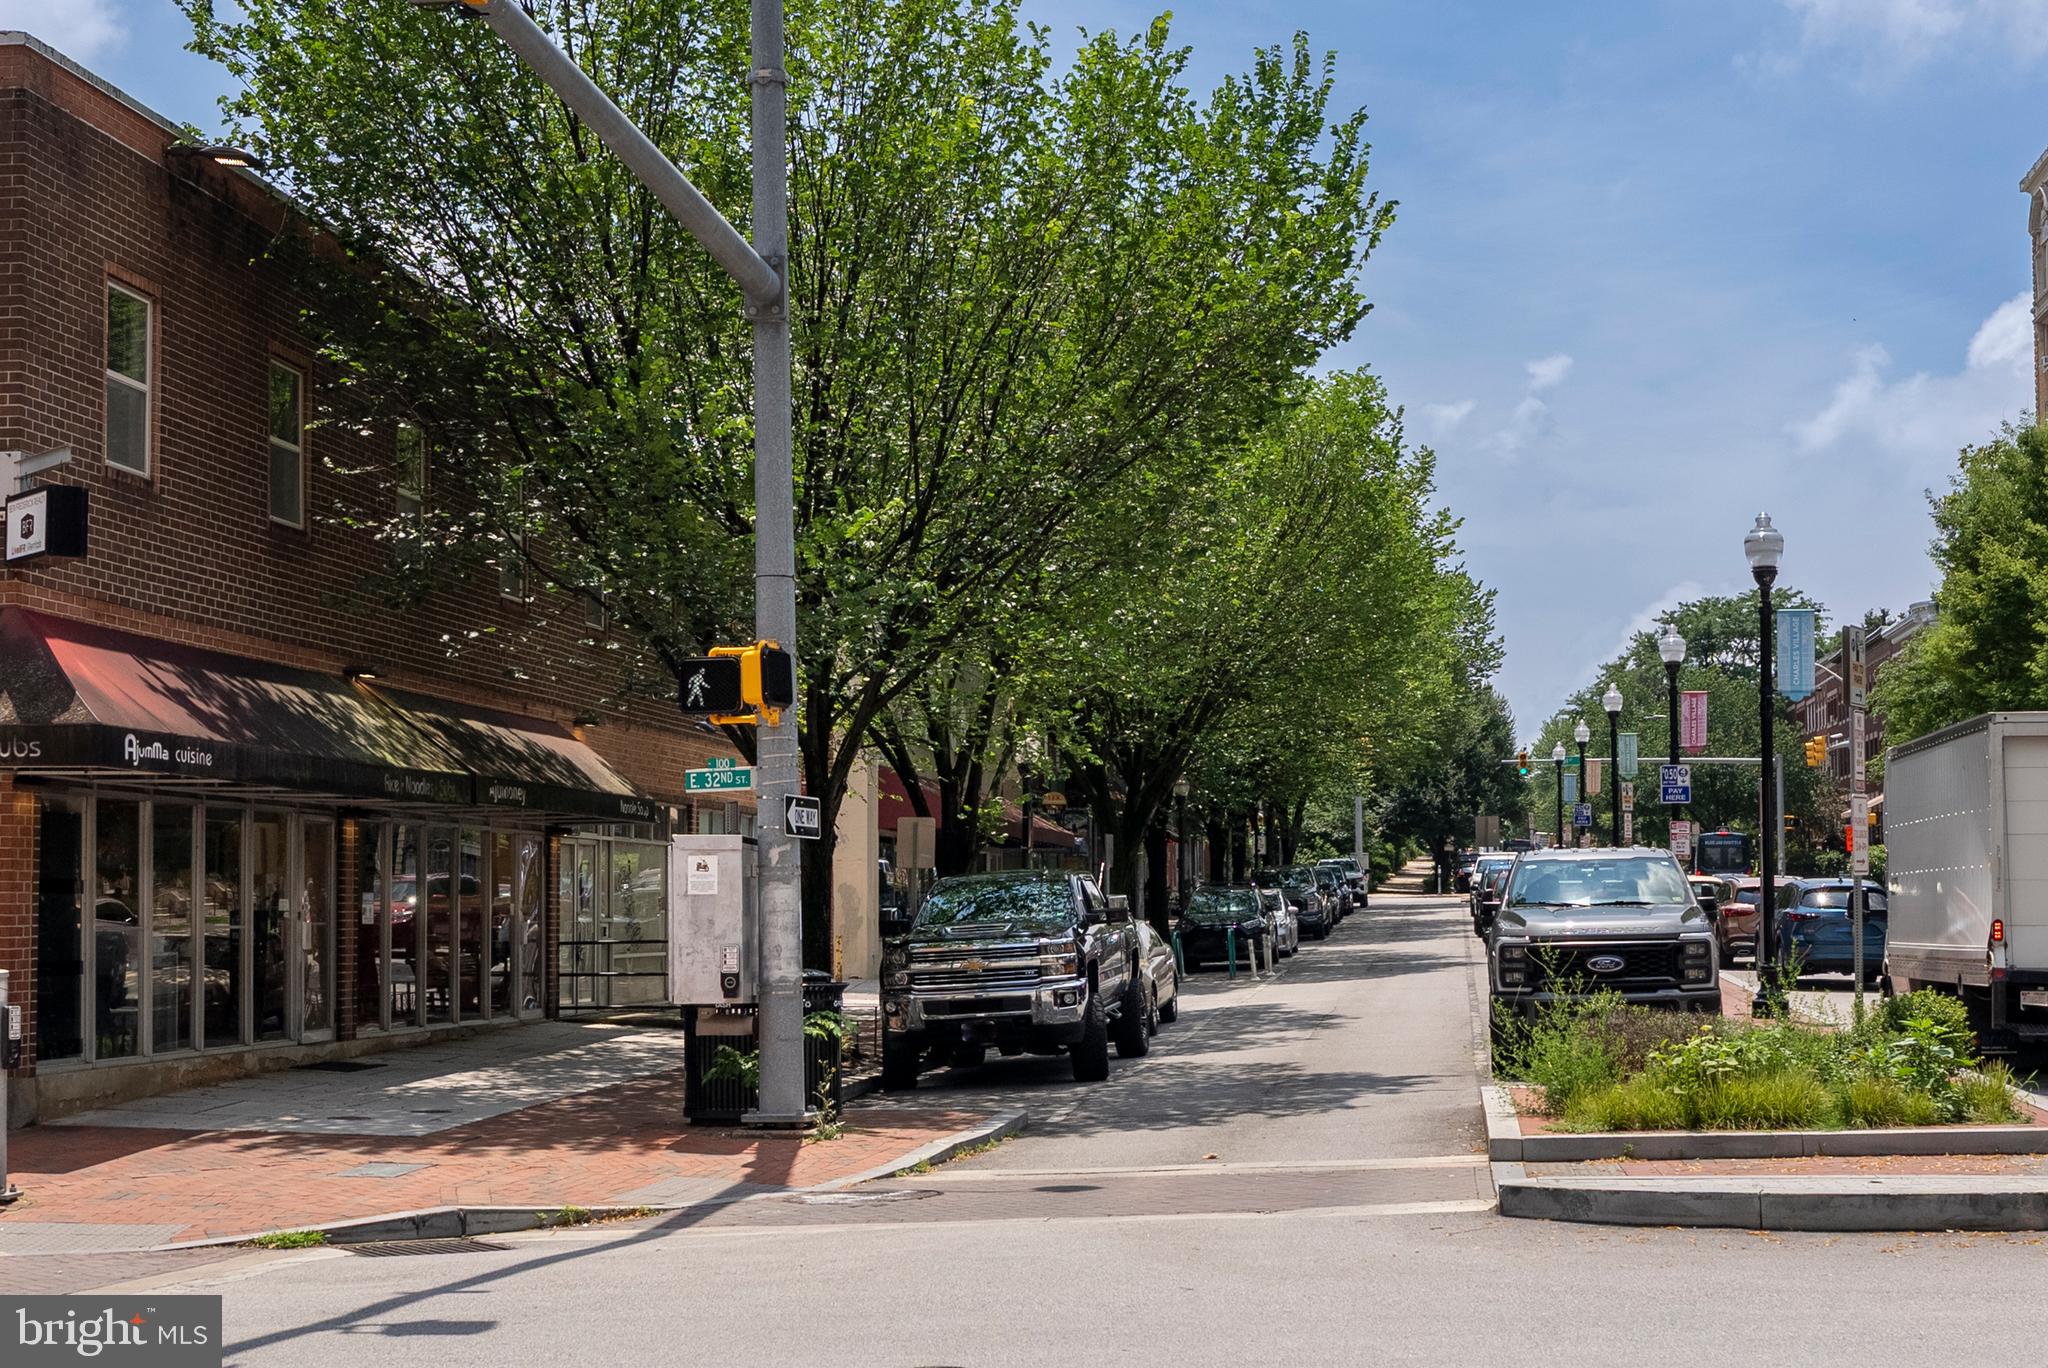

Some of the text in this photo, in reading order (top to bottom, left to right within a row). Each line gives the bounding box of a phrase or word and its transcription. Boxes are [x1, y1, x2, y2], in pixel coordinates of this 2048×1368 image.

[175, 747, 213, 767] cuisine
[715, 758, 730, 768] 100
[384, 774, 400, 793] Rice
[405, 776, 434, 797] Noodles
[690, 771, 748, 789] E. 32ND ST.
[795, 808, 817, 826] ONE WAY
